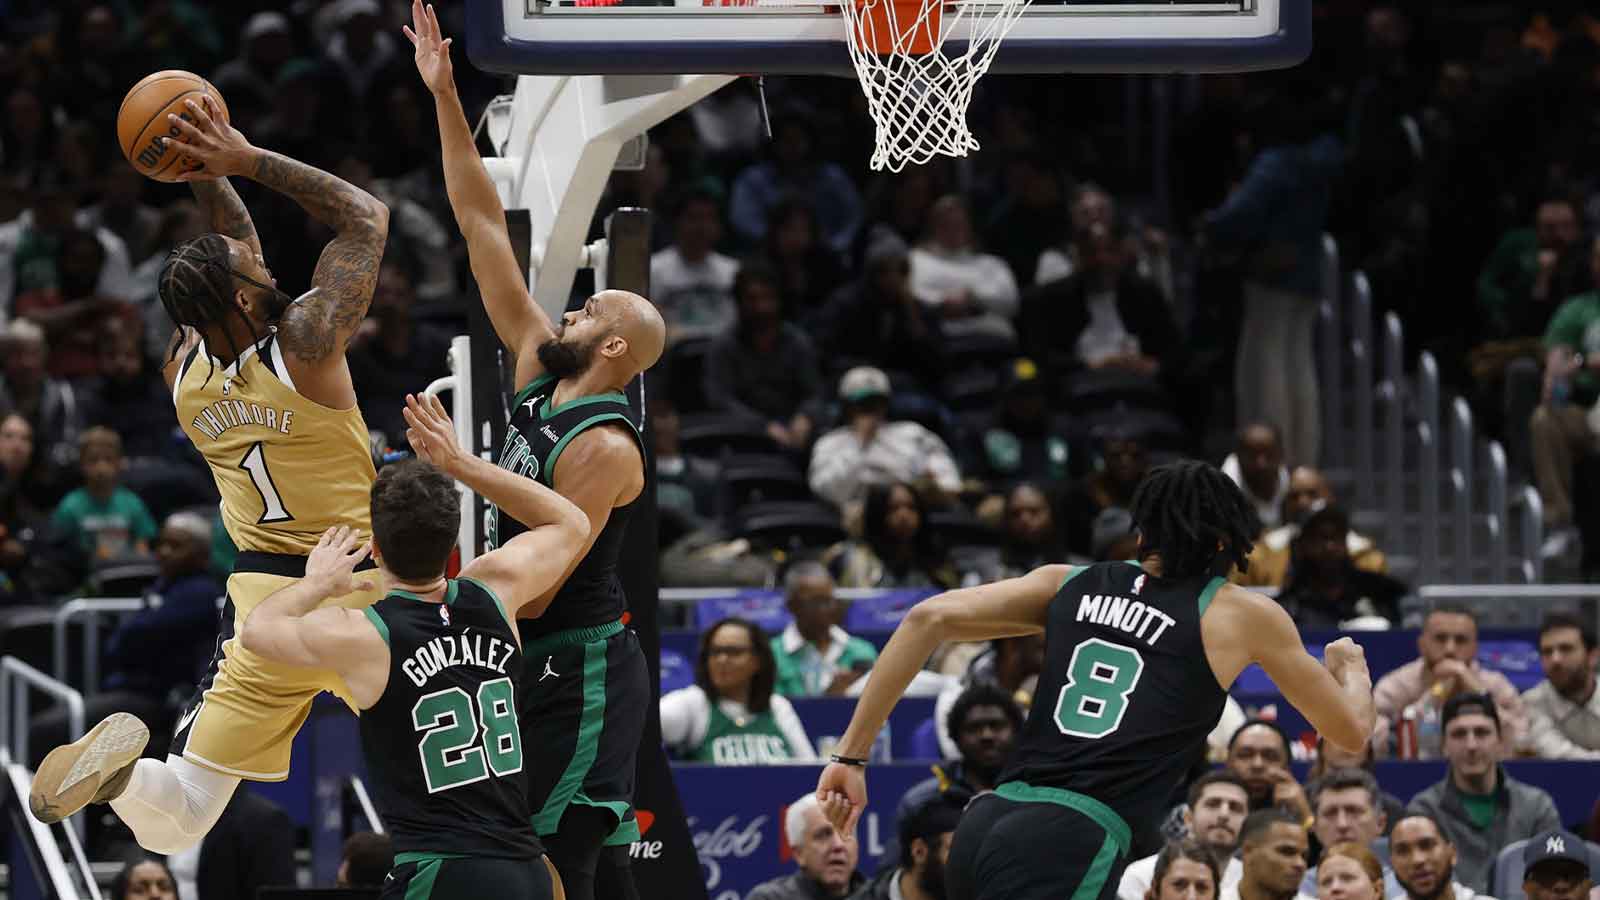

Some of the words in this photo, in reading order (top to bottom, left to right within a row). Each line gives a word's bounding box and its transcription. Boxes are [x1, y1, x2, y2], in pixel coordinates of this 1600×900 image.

[139, 111, 193, 168] Wilo
[192, 399, 294, 442] WHITMORE
[540, 424, 560, 444] Amica
[238, 440, 296, 525] 1
[1075, 594, 1177, 646] MINOTT
[402, 627, 515, 688] GONZÁLEZ
[1053, 637, 1145, 739] 8
[411, 676, 524, 794] 28
